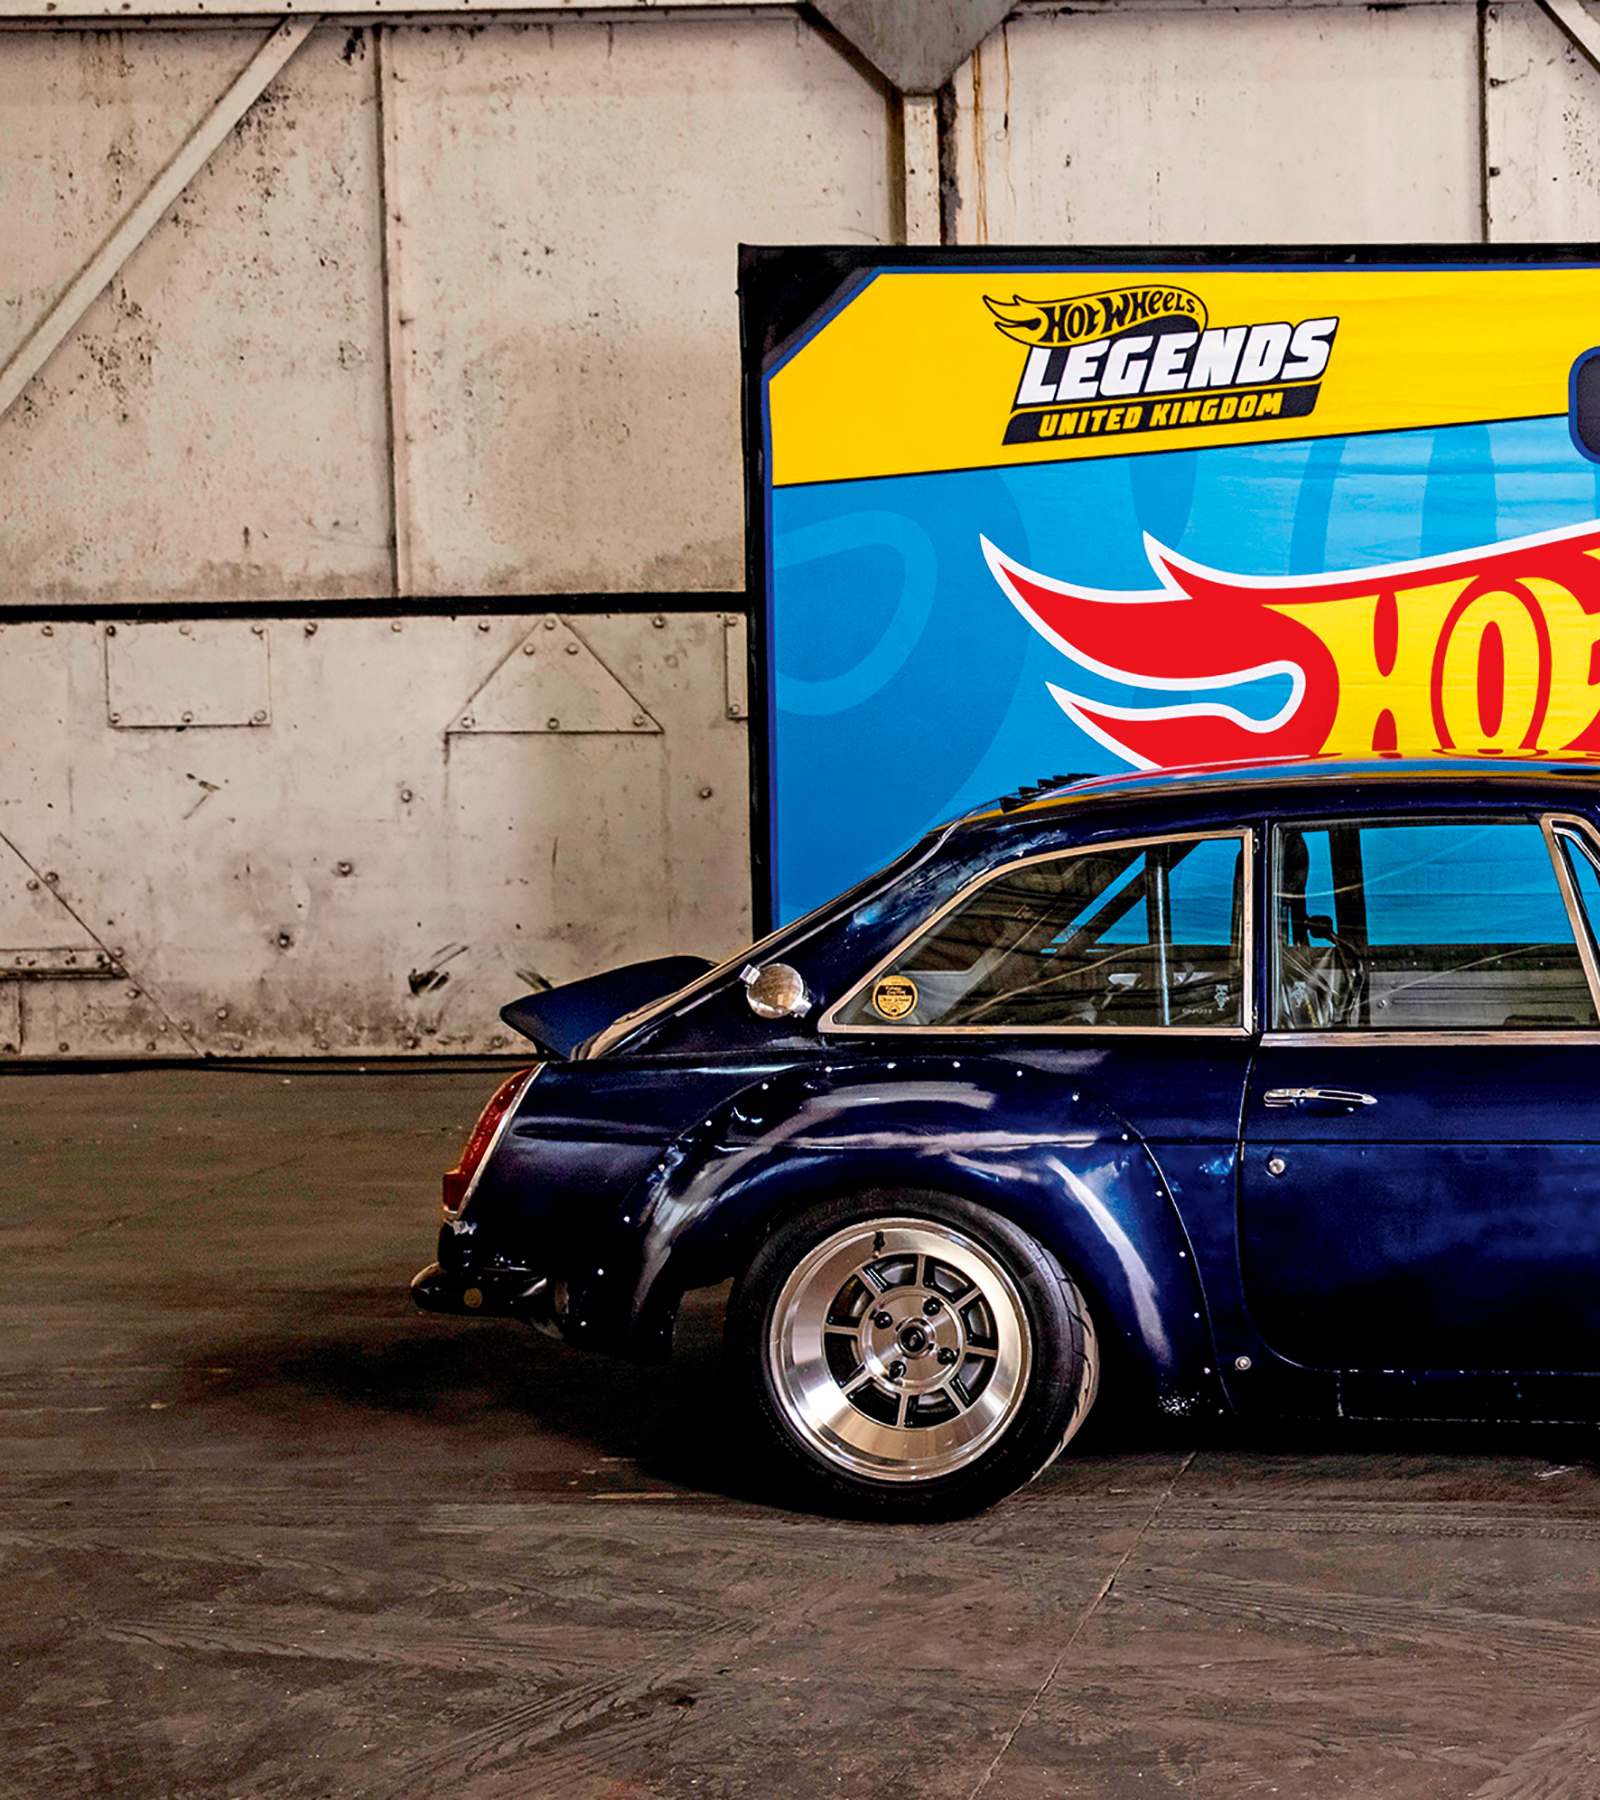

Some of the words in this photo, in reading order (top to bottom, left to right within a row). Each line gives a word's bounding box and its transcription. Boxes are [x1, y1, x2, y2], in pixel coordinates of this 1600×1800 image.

[1016, 317, 1339, 405] LEGENDS
[1037, 406, 1142, 439] UNITED
[1149, 391, 1284, 428] KINGDOM
